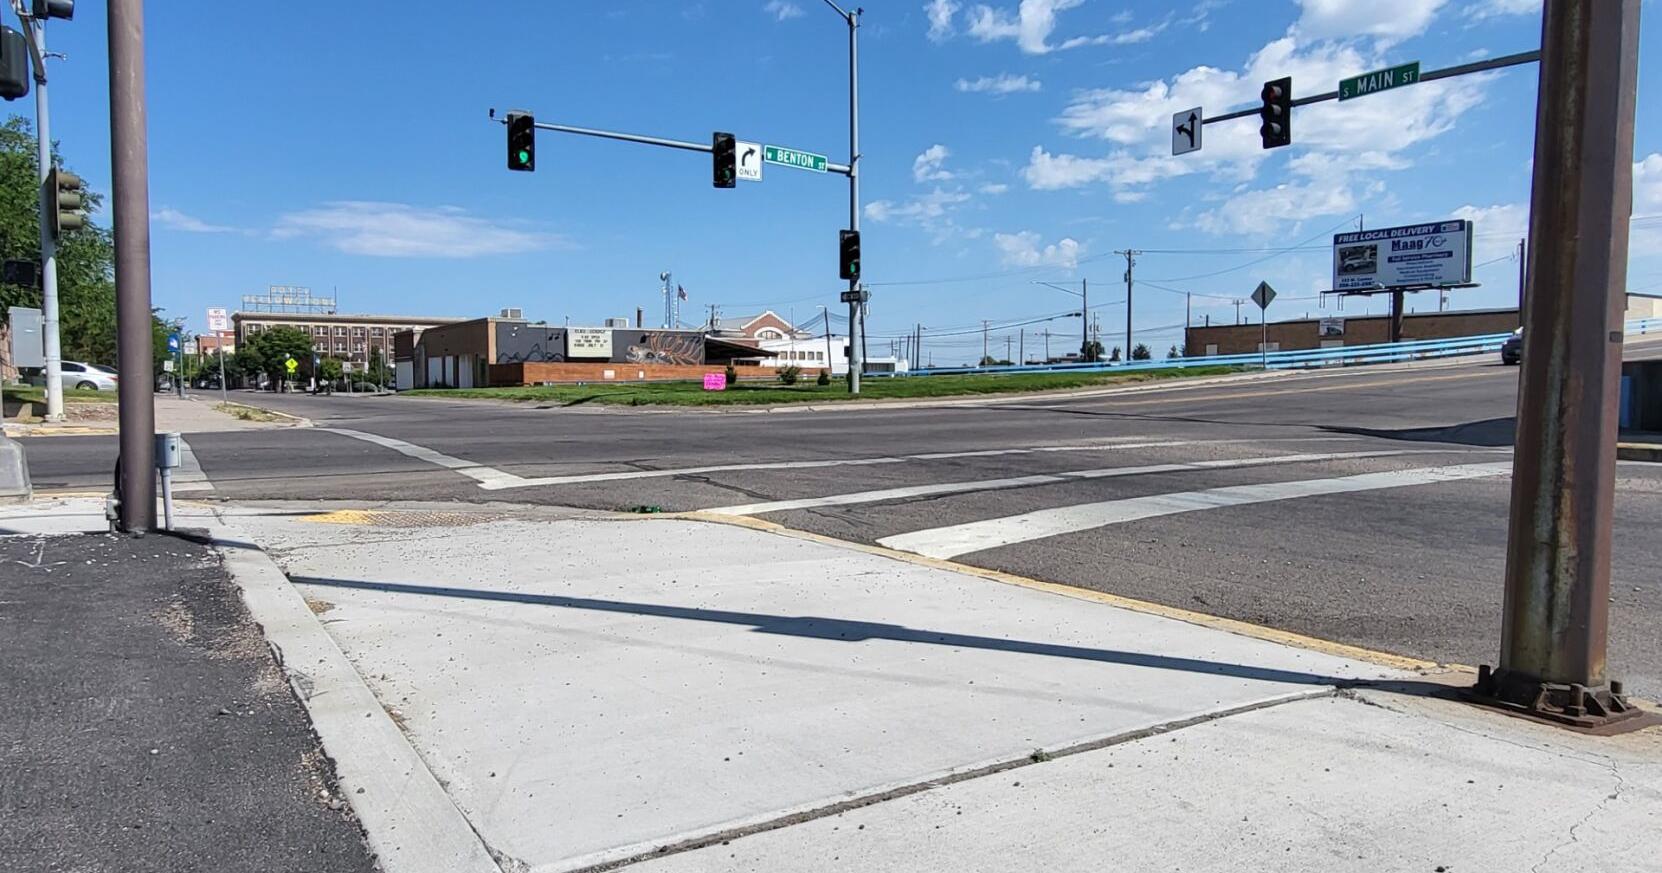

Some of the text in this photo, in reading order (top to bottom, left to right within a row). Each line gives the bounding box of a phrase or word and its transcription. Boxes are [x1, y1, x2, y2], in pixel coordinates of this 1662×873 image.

[1343, 70, 1414, 97] S MAIN ST
[777, 150, 814, 167] BENTON
[818, 161, 825, 170] ST
[738, 167, 758, 177] ONLY
[1338, 225, 1436, 243] FREE LOCAL DELIVERY
[1391, 238, 1424, 251] Maag
